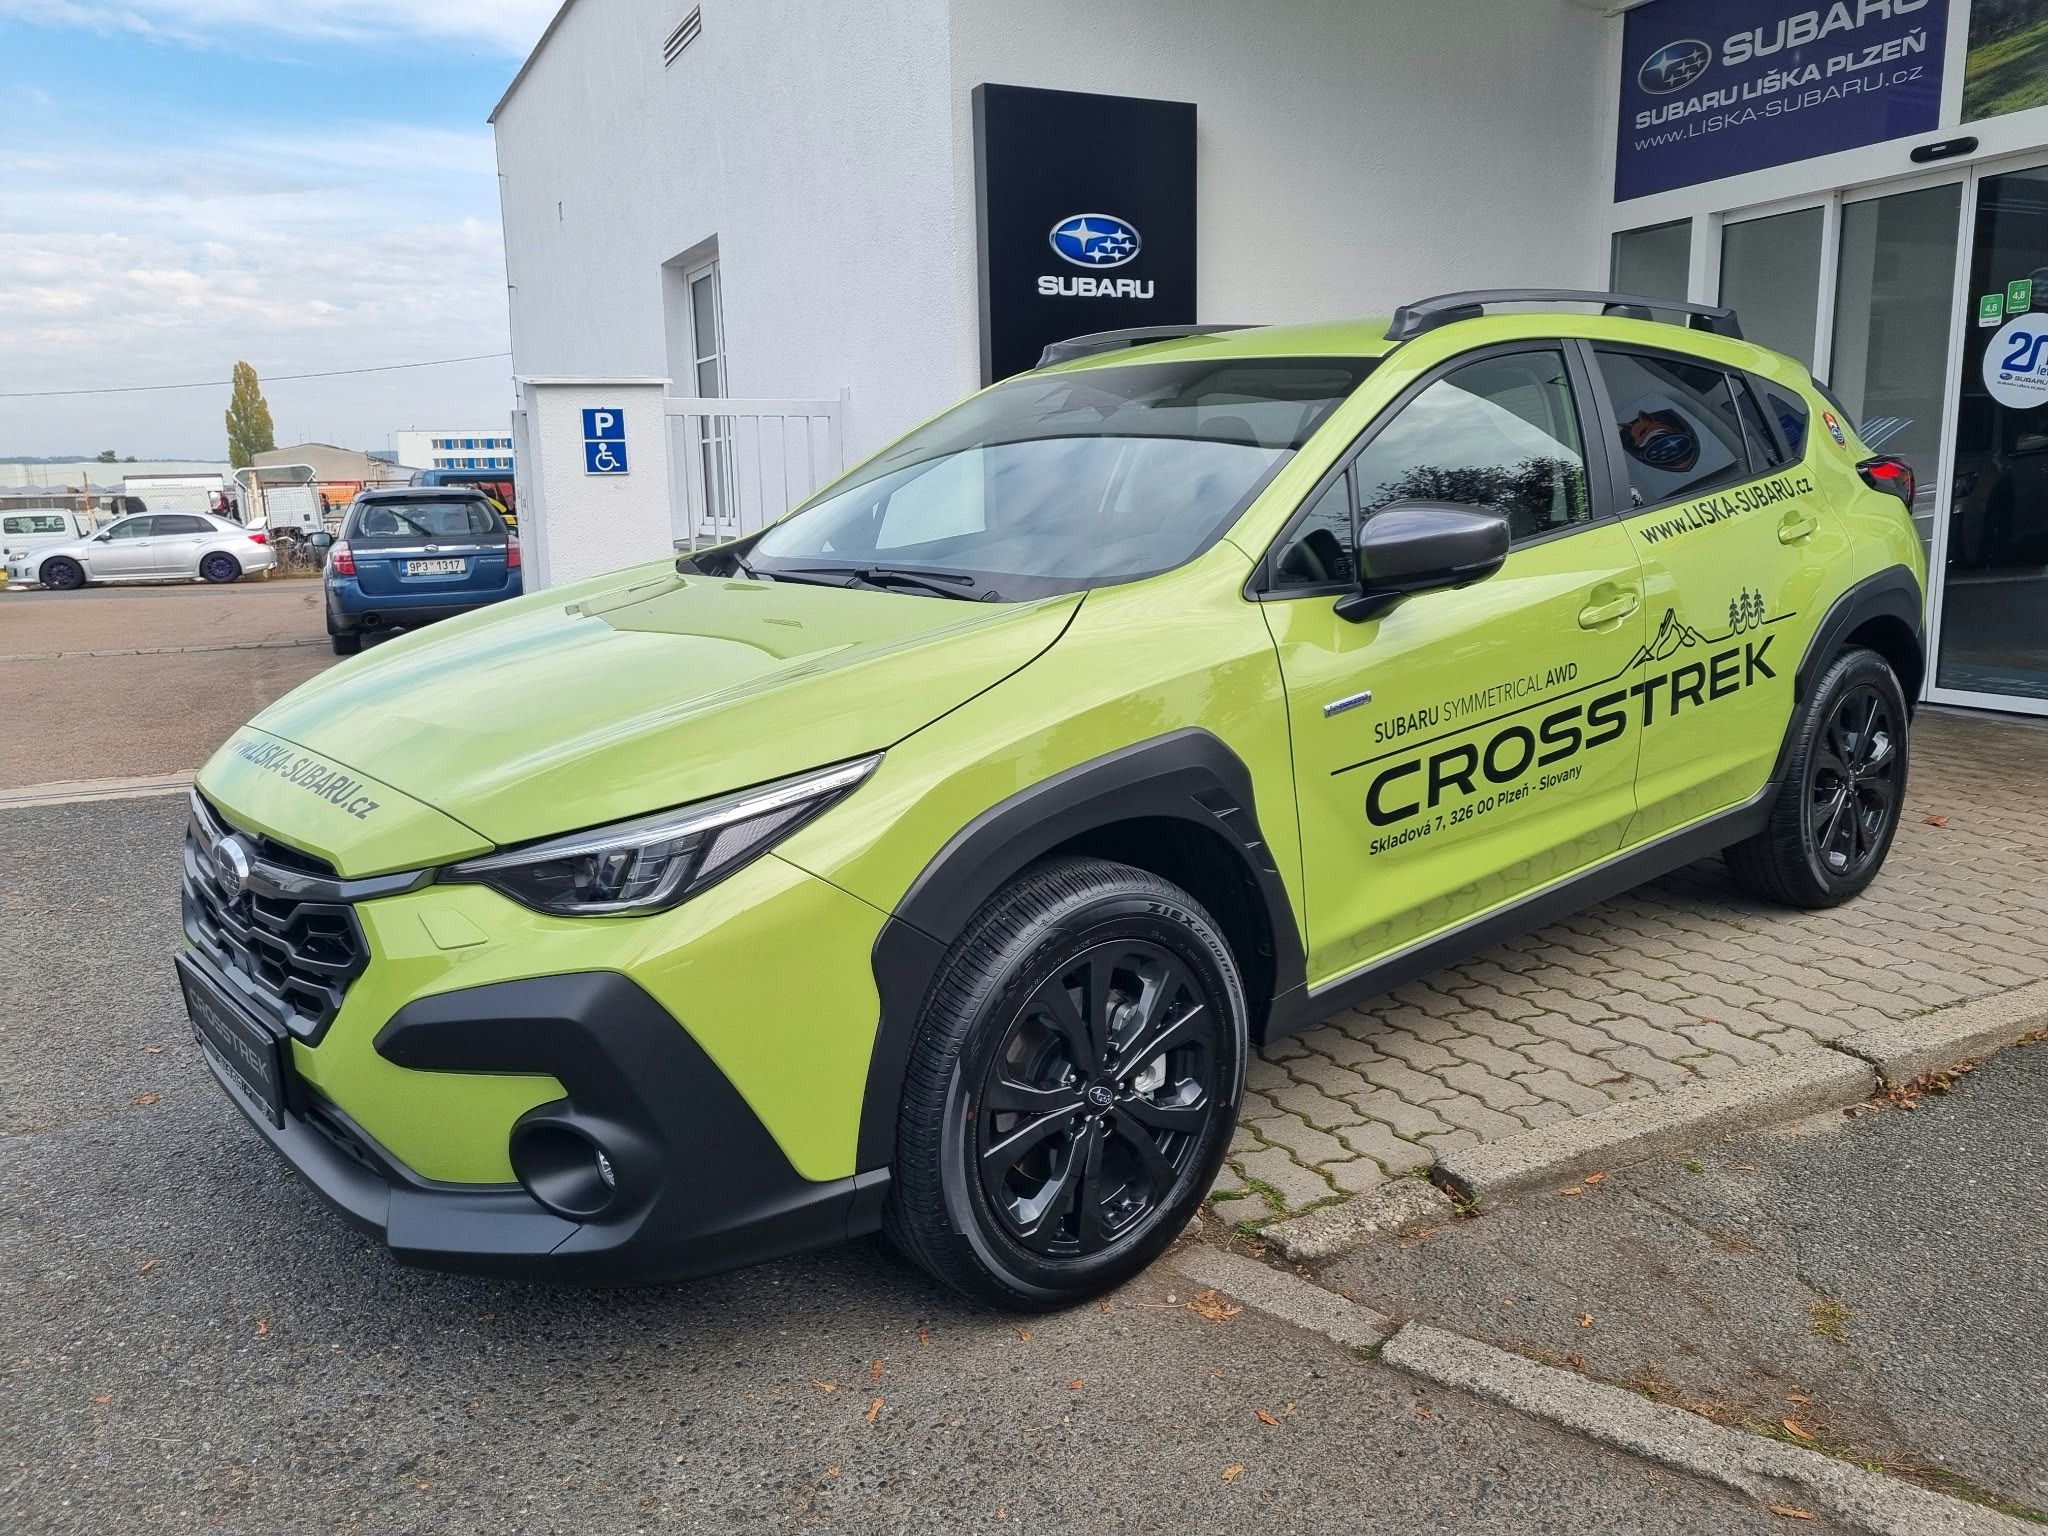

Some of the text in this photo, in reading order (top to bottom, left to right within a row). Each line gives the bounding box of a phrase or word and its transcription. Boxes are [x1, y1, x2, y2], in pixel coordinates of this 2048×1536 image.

[1634, 65, 1924, 151] www.LISKA-SUBARU.cz
[1635, 26, 1927, 130] SUBARU LIŠKA PLZEŇ
[1037, 275, 1154, 299] SUBARU
[1984, 303, 1998, 313] 4,8
[2012, 290, 2026, 301] 4,8
[594, 412, 614, 437] P
[1639, 476, 1814, 544] www.LISKA-SUBARU.cz
[409, 561, 429, 572] 9P3
[436, 560, 460, 571] 1317
[1365, 633, 1777, 827] CROSSTREK
[1374, 662, 1578, 744] SUBARU SYMMETRICAL AWD
[1369, 819, 1431, 856] Skladová
[1435, 815, 1446, 832] 7,
[1450, 803, 1473, 827] 326
[1476, 796, 1494, 815] 00
[1497, 782, 1529, 808] Plzeň
[1539, 764, 1583, 792] Slovany
[1144, 902, 1197, 929] ZIEX
[188, 987, 272, 1084] CROSSTREK
